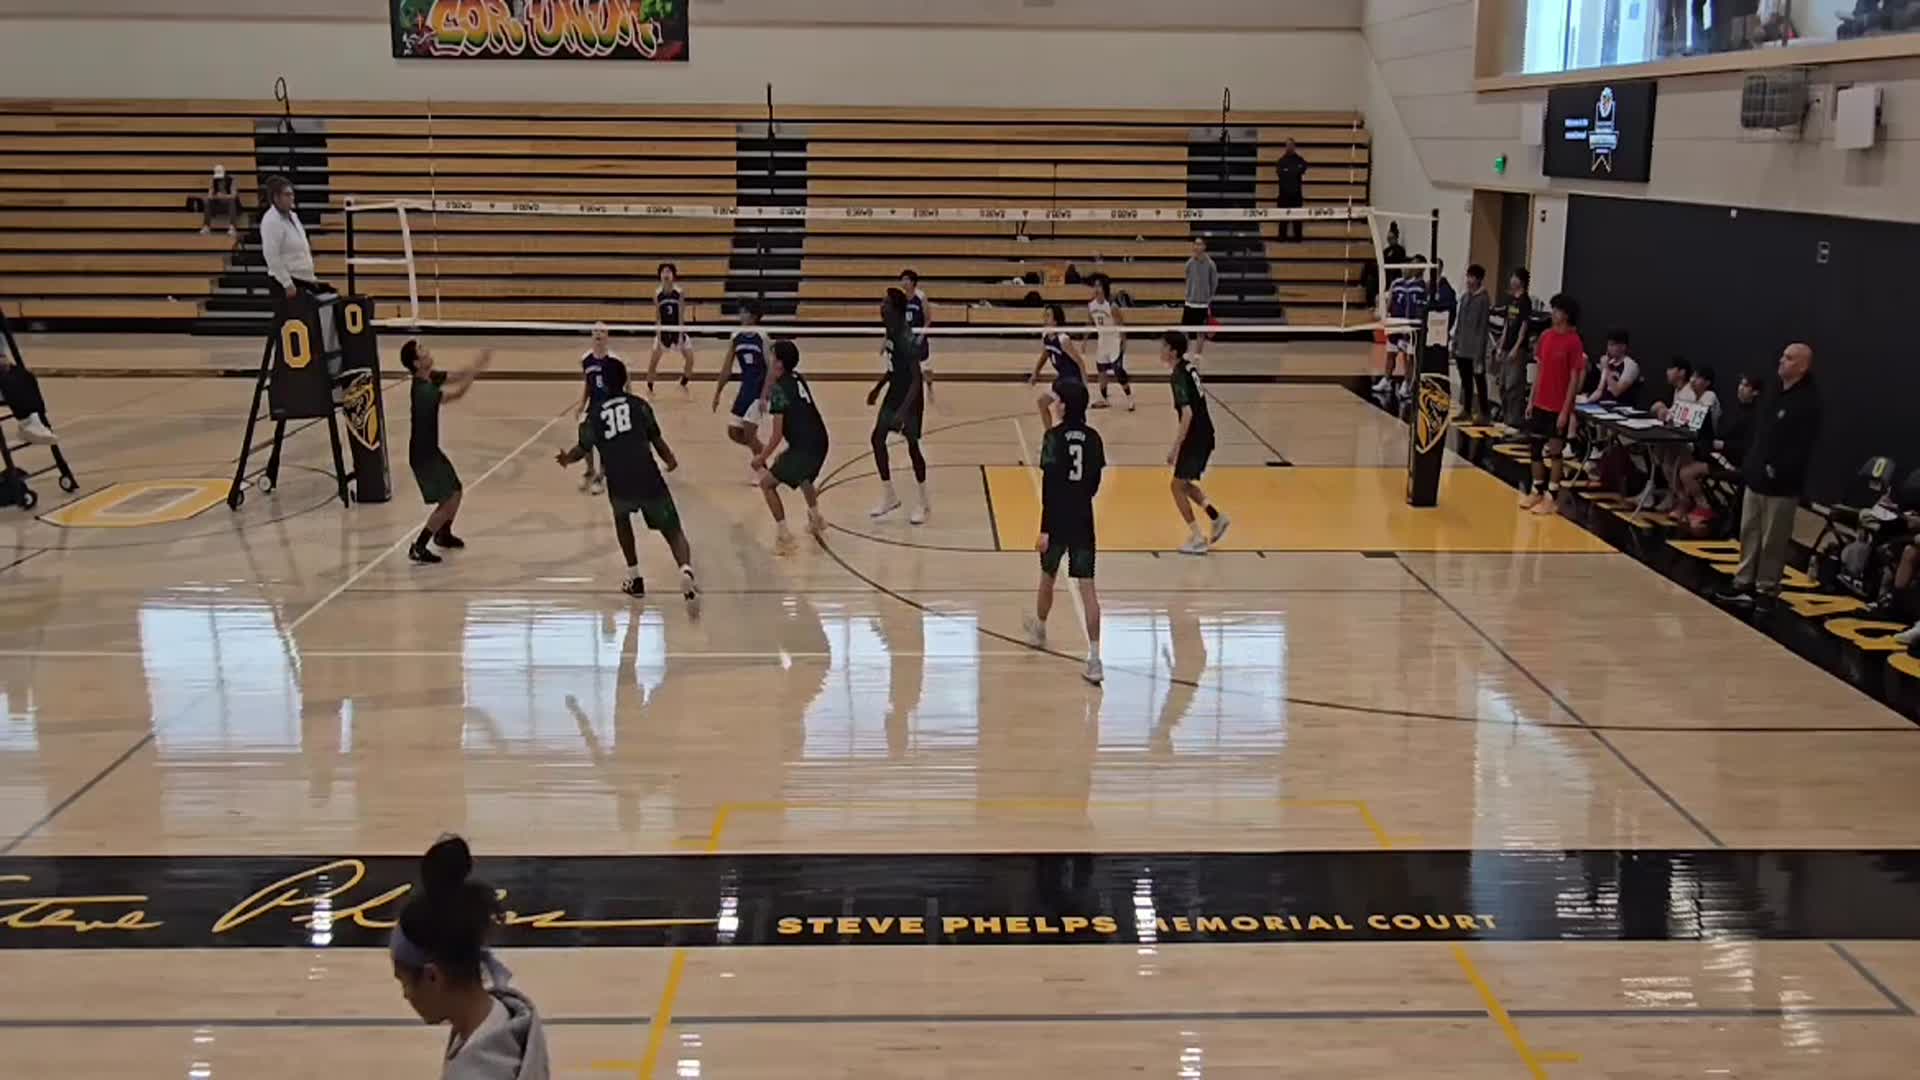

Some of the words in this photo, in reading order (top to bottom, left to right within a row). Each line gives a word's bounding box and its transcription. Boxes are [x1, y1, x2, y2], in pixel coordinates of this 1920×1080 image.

[600, 402, 632, 440] 38
[1068, 444, 1083, 481] 3
[777, 916, 925, 935] STEVE
[942, 916, 1118, 935] PHELPS
[1367, 914, 1497, 930] COURT
